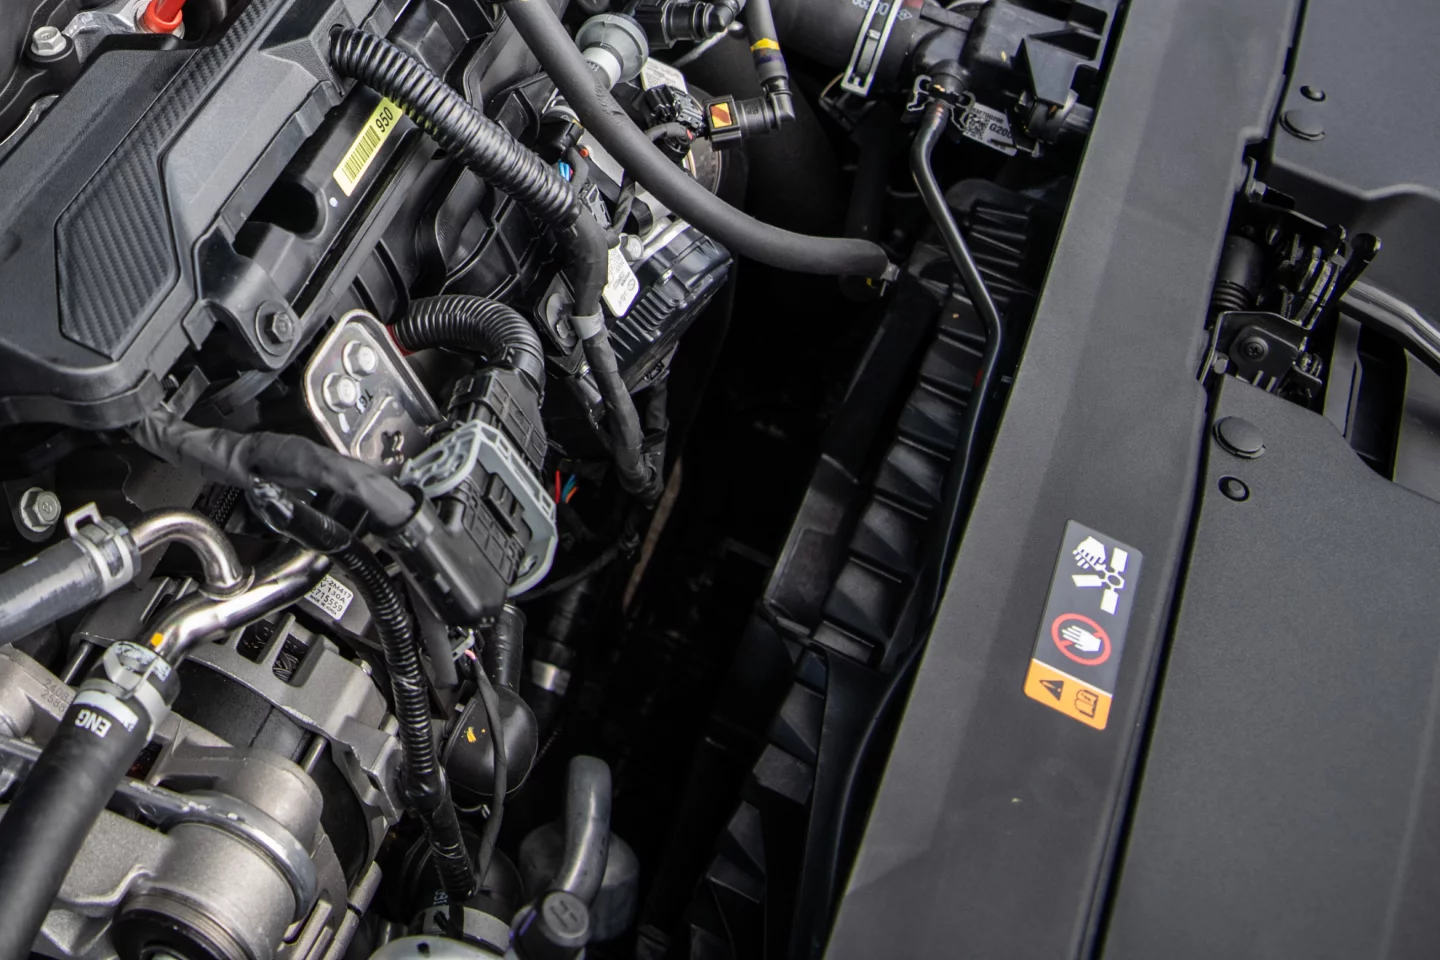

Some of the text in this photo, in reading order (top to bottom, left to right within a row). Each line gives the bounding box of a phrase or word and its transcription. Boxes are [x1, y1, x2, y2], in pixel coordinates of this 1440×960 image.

[374, 106, 394, 133] 950
[327, 587, 345, 604] 130A
[42, 678, 74, 705] 2408
[74, 708, 113, 738] ENG
